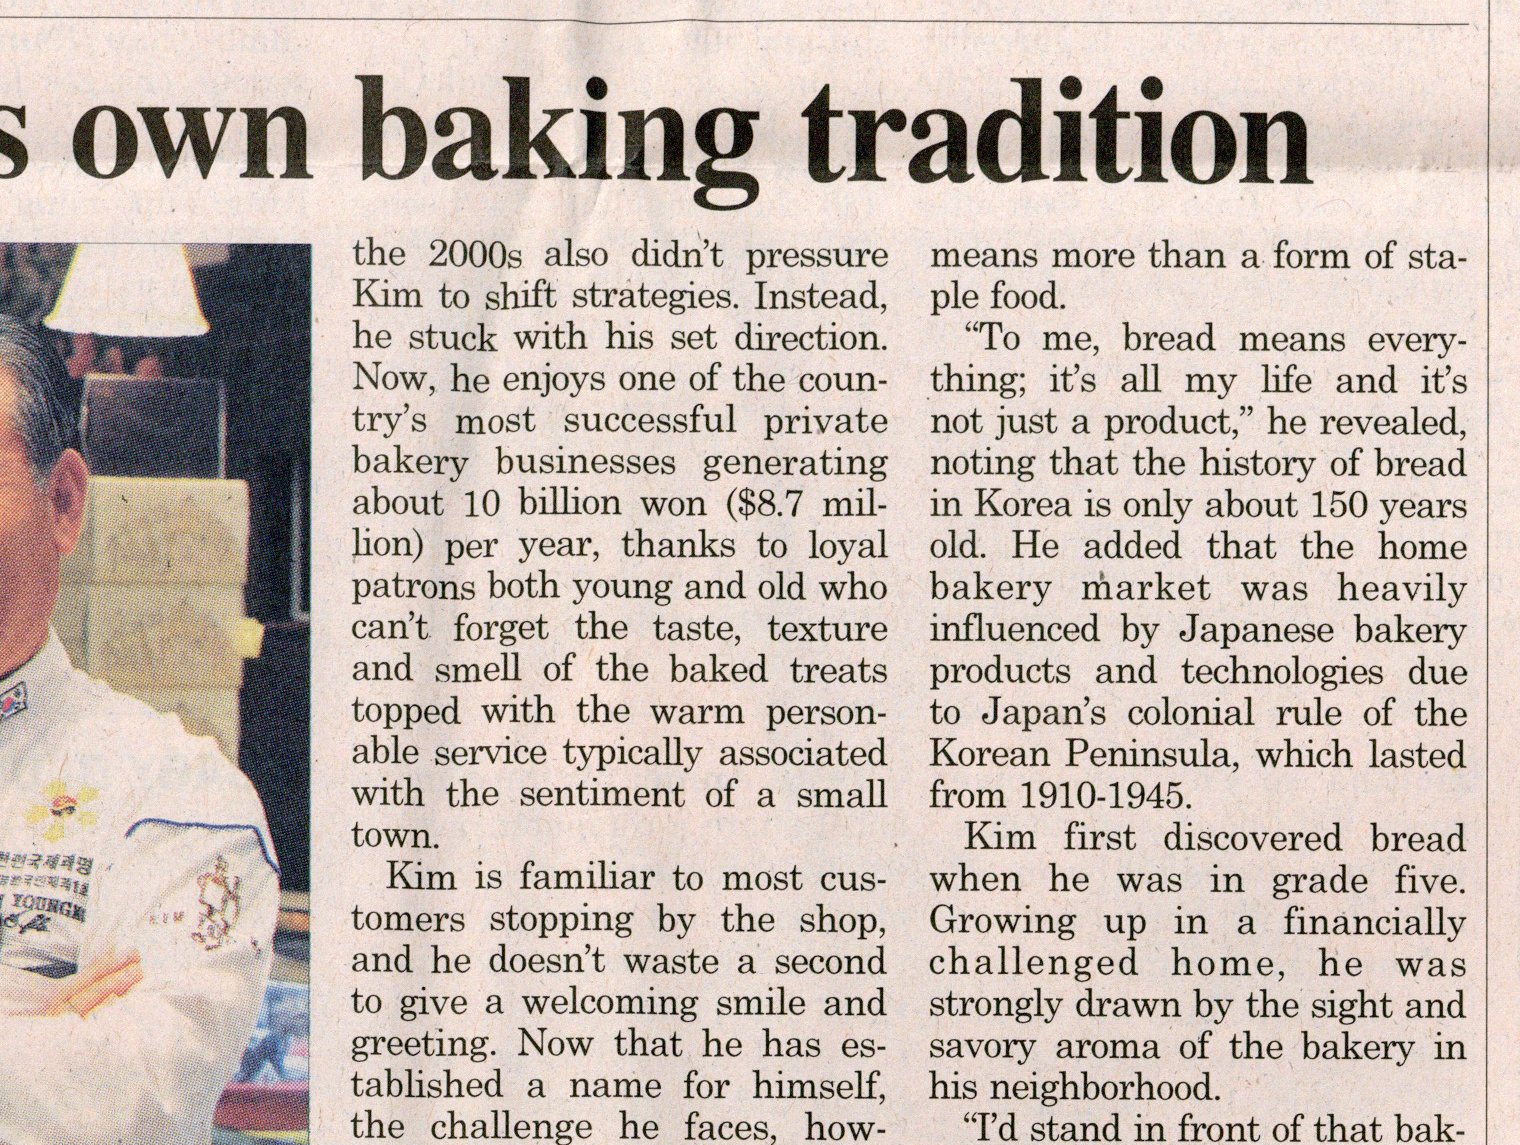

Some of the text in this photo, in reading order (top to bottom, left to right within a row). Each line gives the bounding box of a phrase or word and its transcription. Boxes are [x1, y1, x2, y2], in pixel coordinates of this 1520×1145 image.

[71, 104, 314, 180] own
[354, 74, 761, 212] baking
[800, 74, 1315, 186] tradition
[351, 443, 889, 483] bakery businesses generating
[929, 487, 1468, 526] in Korea is only about 150 years
[351, 568, 888, 607] patrons both young and old who
[928, 737, 1468, 774] Korean Peninsula, which lasted
[929, 987, 1467, 1026] strongly drawn by the sight and
[351, 1026, 887, 1064] greeting. Now that he has es-
